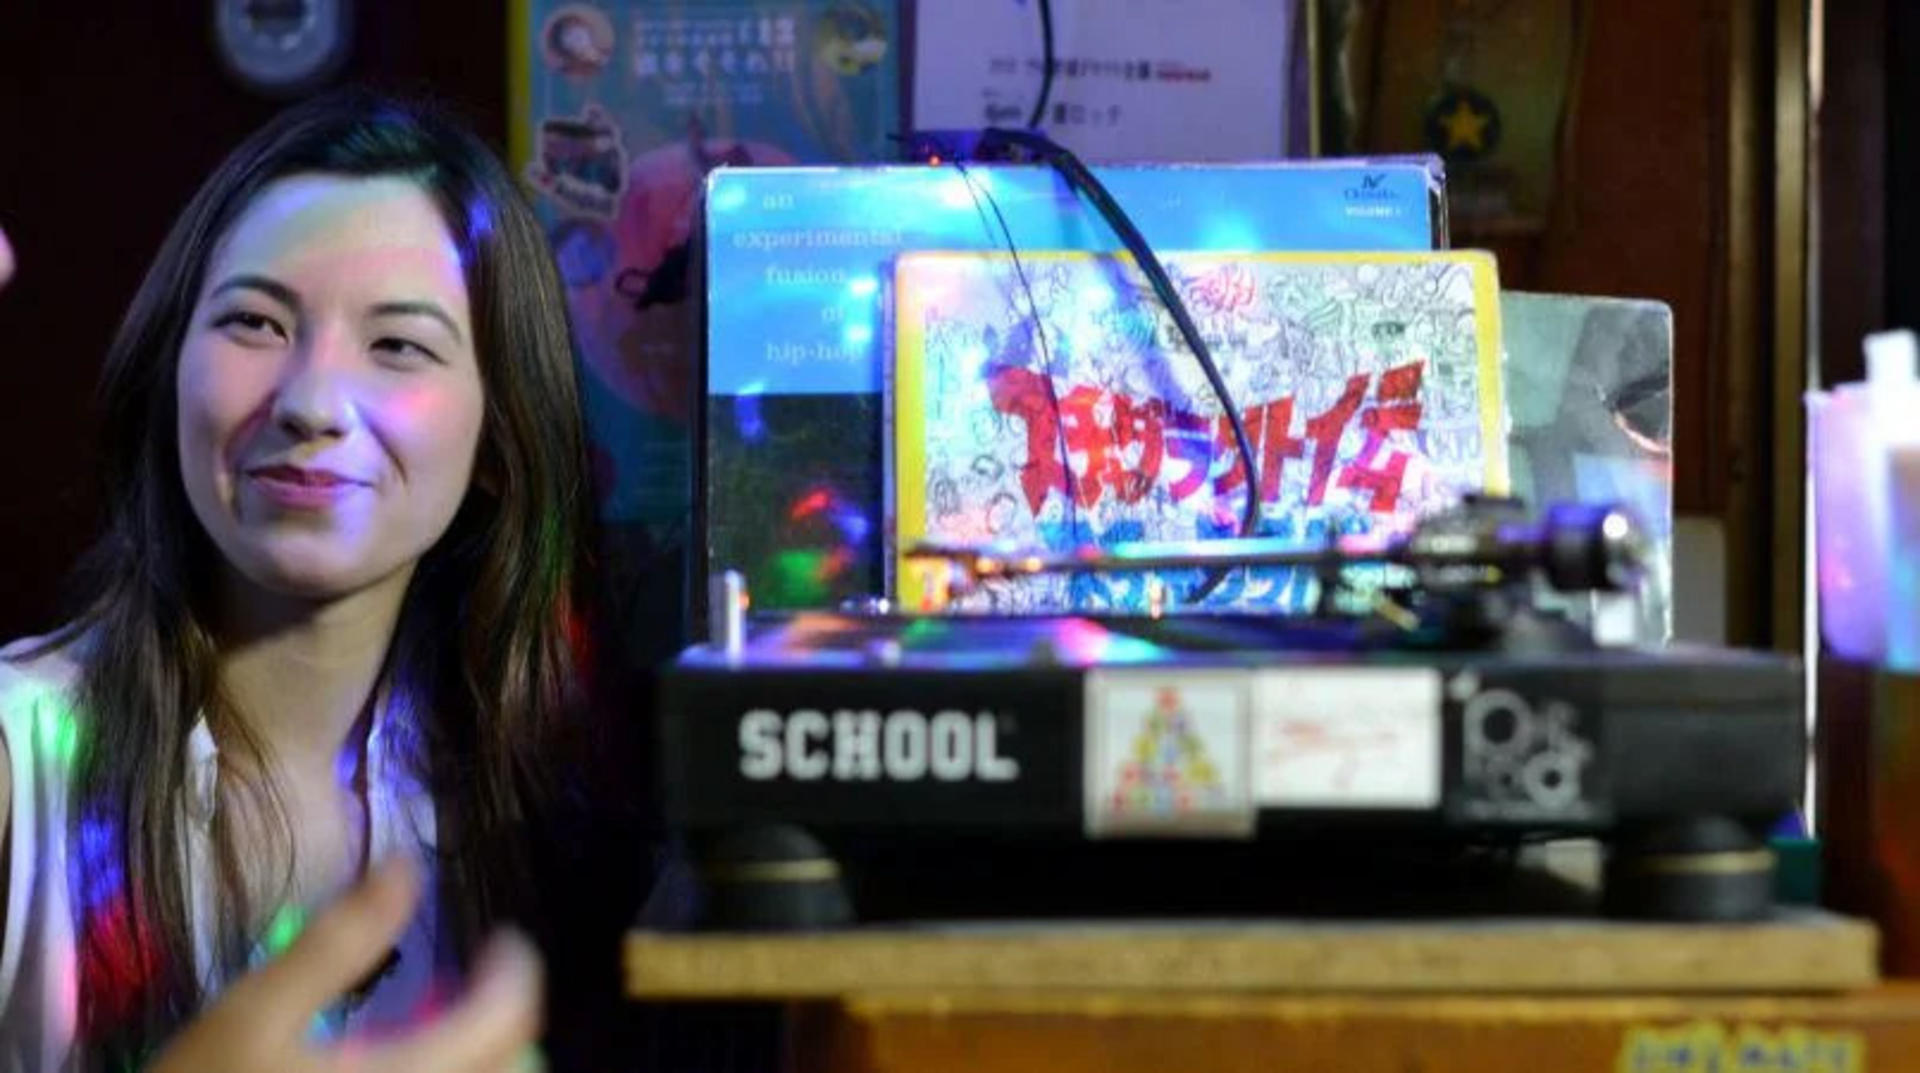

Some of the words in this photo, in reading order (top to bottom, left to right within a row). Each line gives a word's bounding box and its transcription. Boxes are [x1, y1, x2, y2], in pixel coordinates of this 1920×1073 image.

[762, 191, 795, 210] an
[732, 228, 902, 251] experimental
[764, 262, 845, 285] fusion
[739, 708, 1020, 782] SCHOOL
